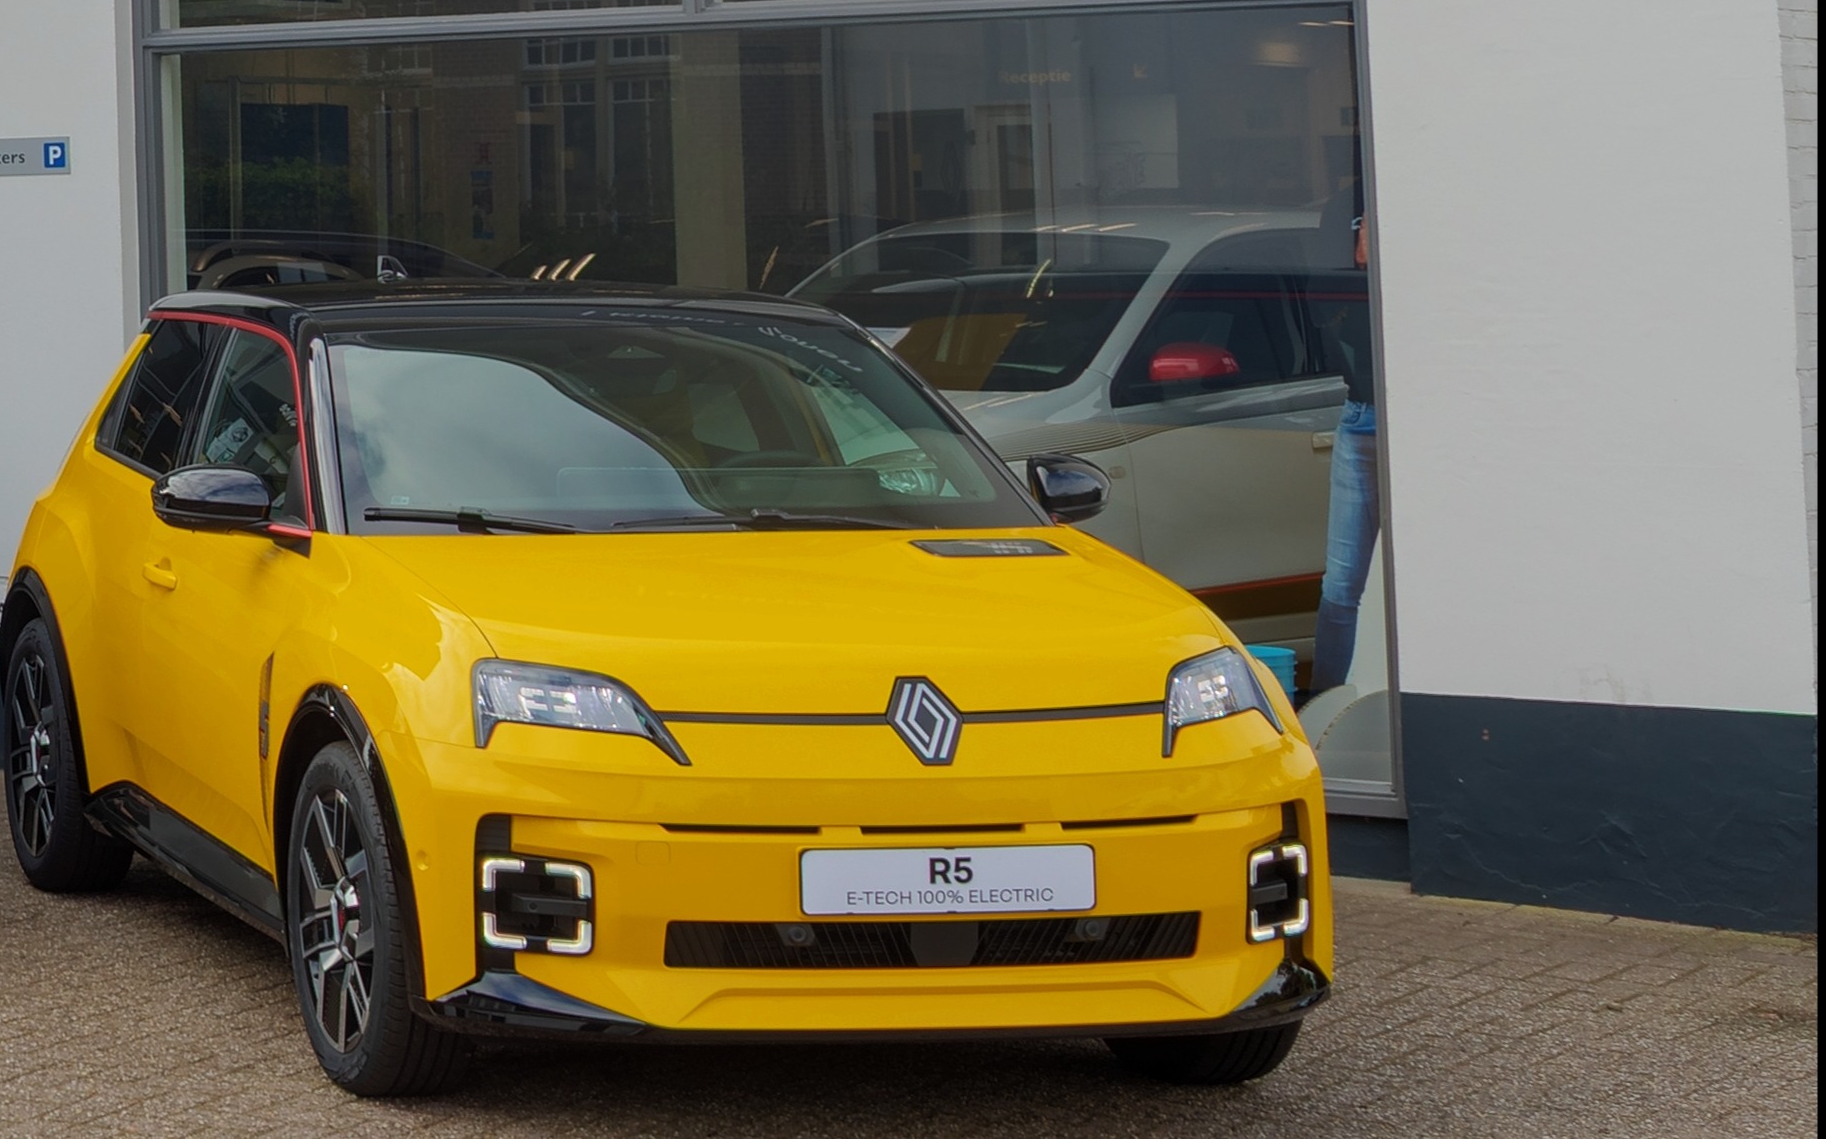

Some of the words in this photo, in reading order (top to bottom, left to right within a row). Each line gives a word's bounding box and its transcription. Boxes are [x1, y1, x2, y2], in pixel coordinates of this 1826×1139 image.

[48, 145, 62, 165] P
[929, 856, 974, 885] R5
[846, 890, 912, 906] E-TECH
[917, 889, 964, 905] 100%
[968, 887, 1054, 904] ELECTRIC
